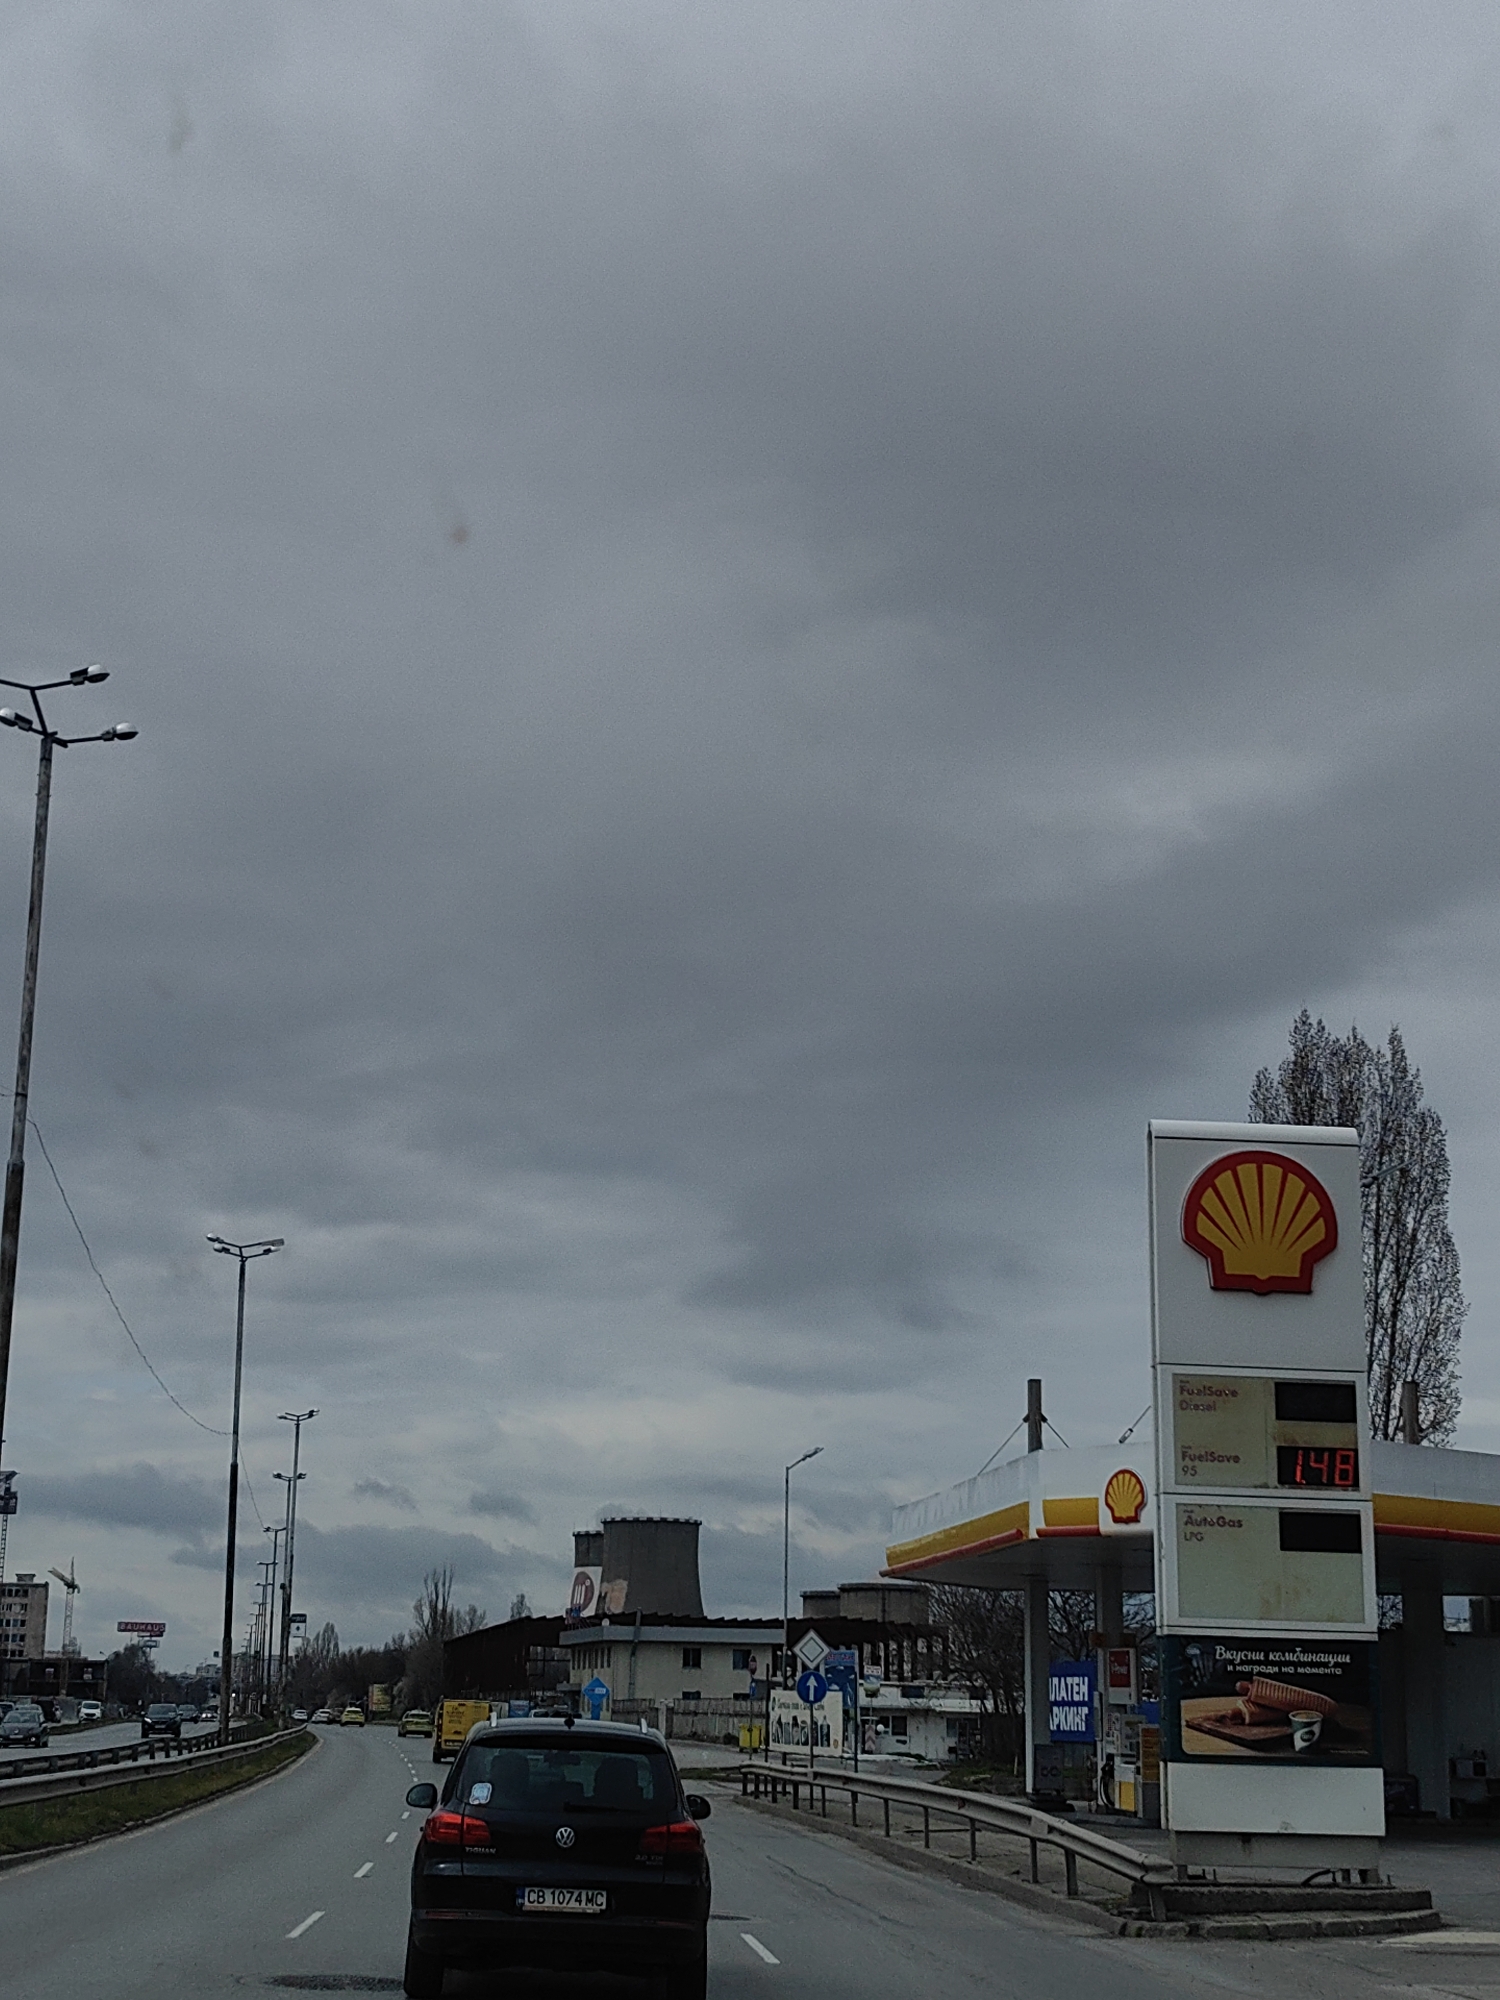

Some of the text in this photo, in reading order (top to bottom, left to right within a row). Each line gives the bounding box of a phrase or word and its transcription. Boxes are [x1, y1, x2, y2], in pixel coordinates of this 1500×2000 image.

[1180, 1386, 1238, 1397] FuelSave
[1180, 1400, 1217, 1411] Diesel
[1182, 1452, 1241, 1464] FuelSave
[1182, 1466, 1198, 1477] 95
[1295, 1449, 1356, 1486] 1.48
[1184, 1515, 1243, 1528] AutoGas
[120, 1623, 165, 1631] BAUHAUS
[1215, 1645, 1264, 1664] Вкусни
[1268, 1647, 1351, 1667] комбинации
[1236, 1664, 1279, 1675] награди
[1297, 1667, 1342, 1675] момента
[1049, 1676, 1088, 1701] ЛАТЕН
[527, 1889, 604, 1907] CB 1074 MC
